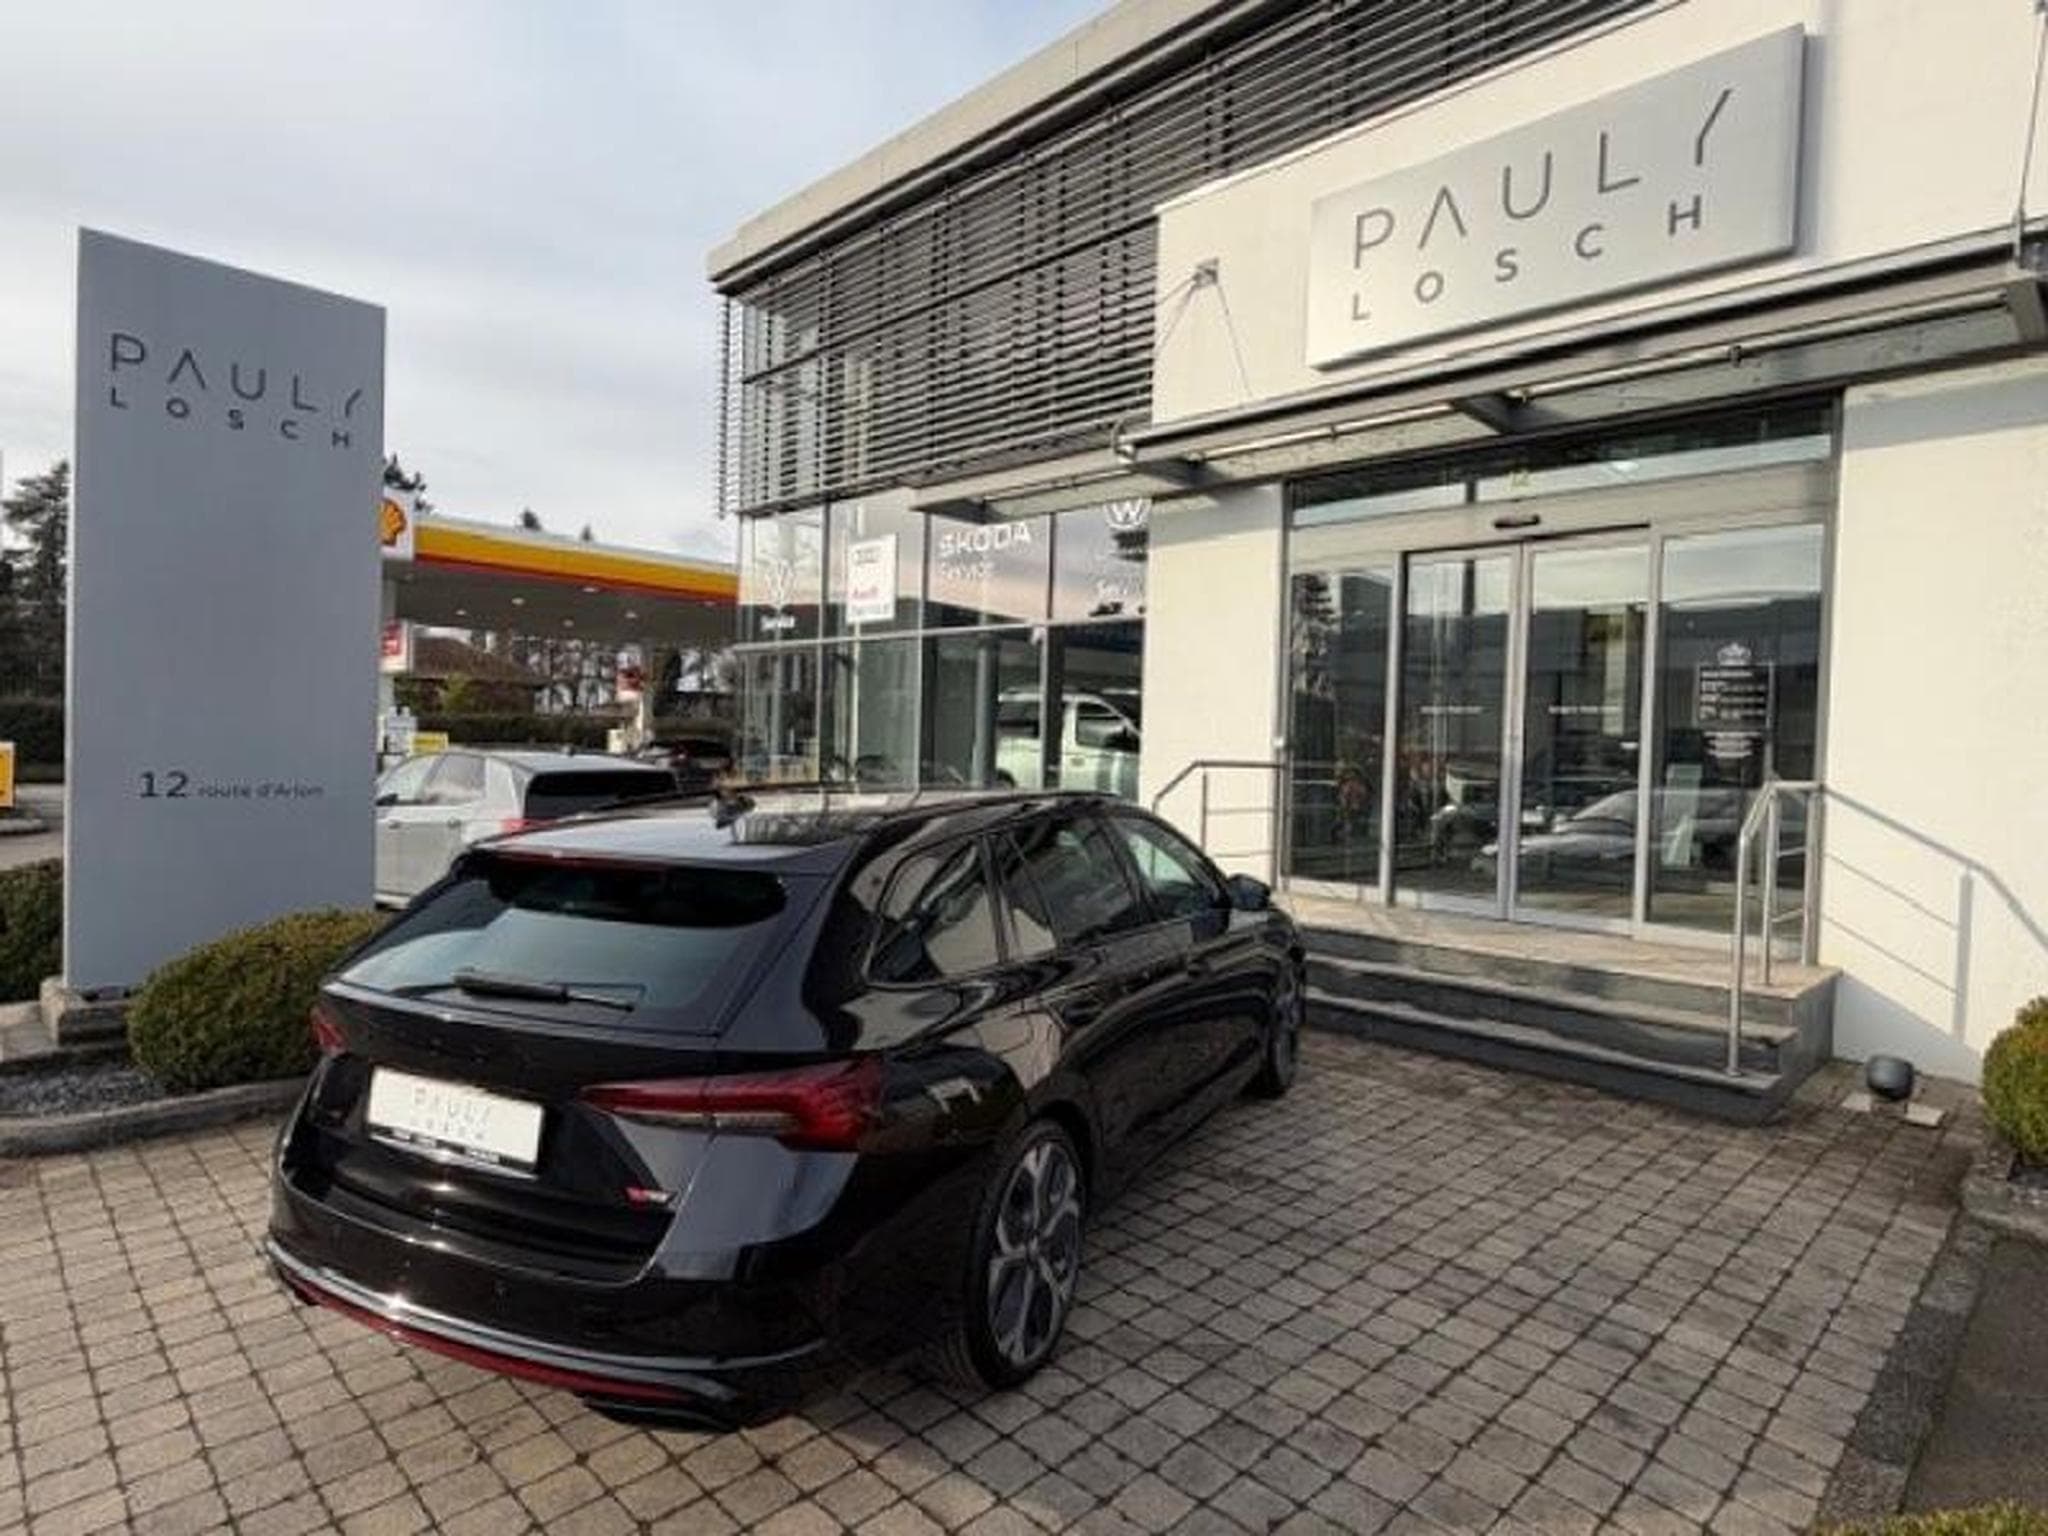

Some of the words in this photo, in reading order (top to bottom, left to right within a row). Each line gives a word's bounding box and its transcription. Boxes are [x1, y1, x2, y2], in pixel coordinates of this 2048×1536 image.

[1354, 88, 1731, 270] PAULY
[1351, 196, 1701, 321] LOSCH
[110, 386, 350, 447] LOSCH
[111, 332, 362, 418] PAULY
[140, 769, 189, 798] 12
